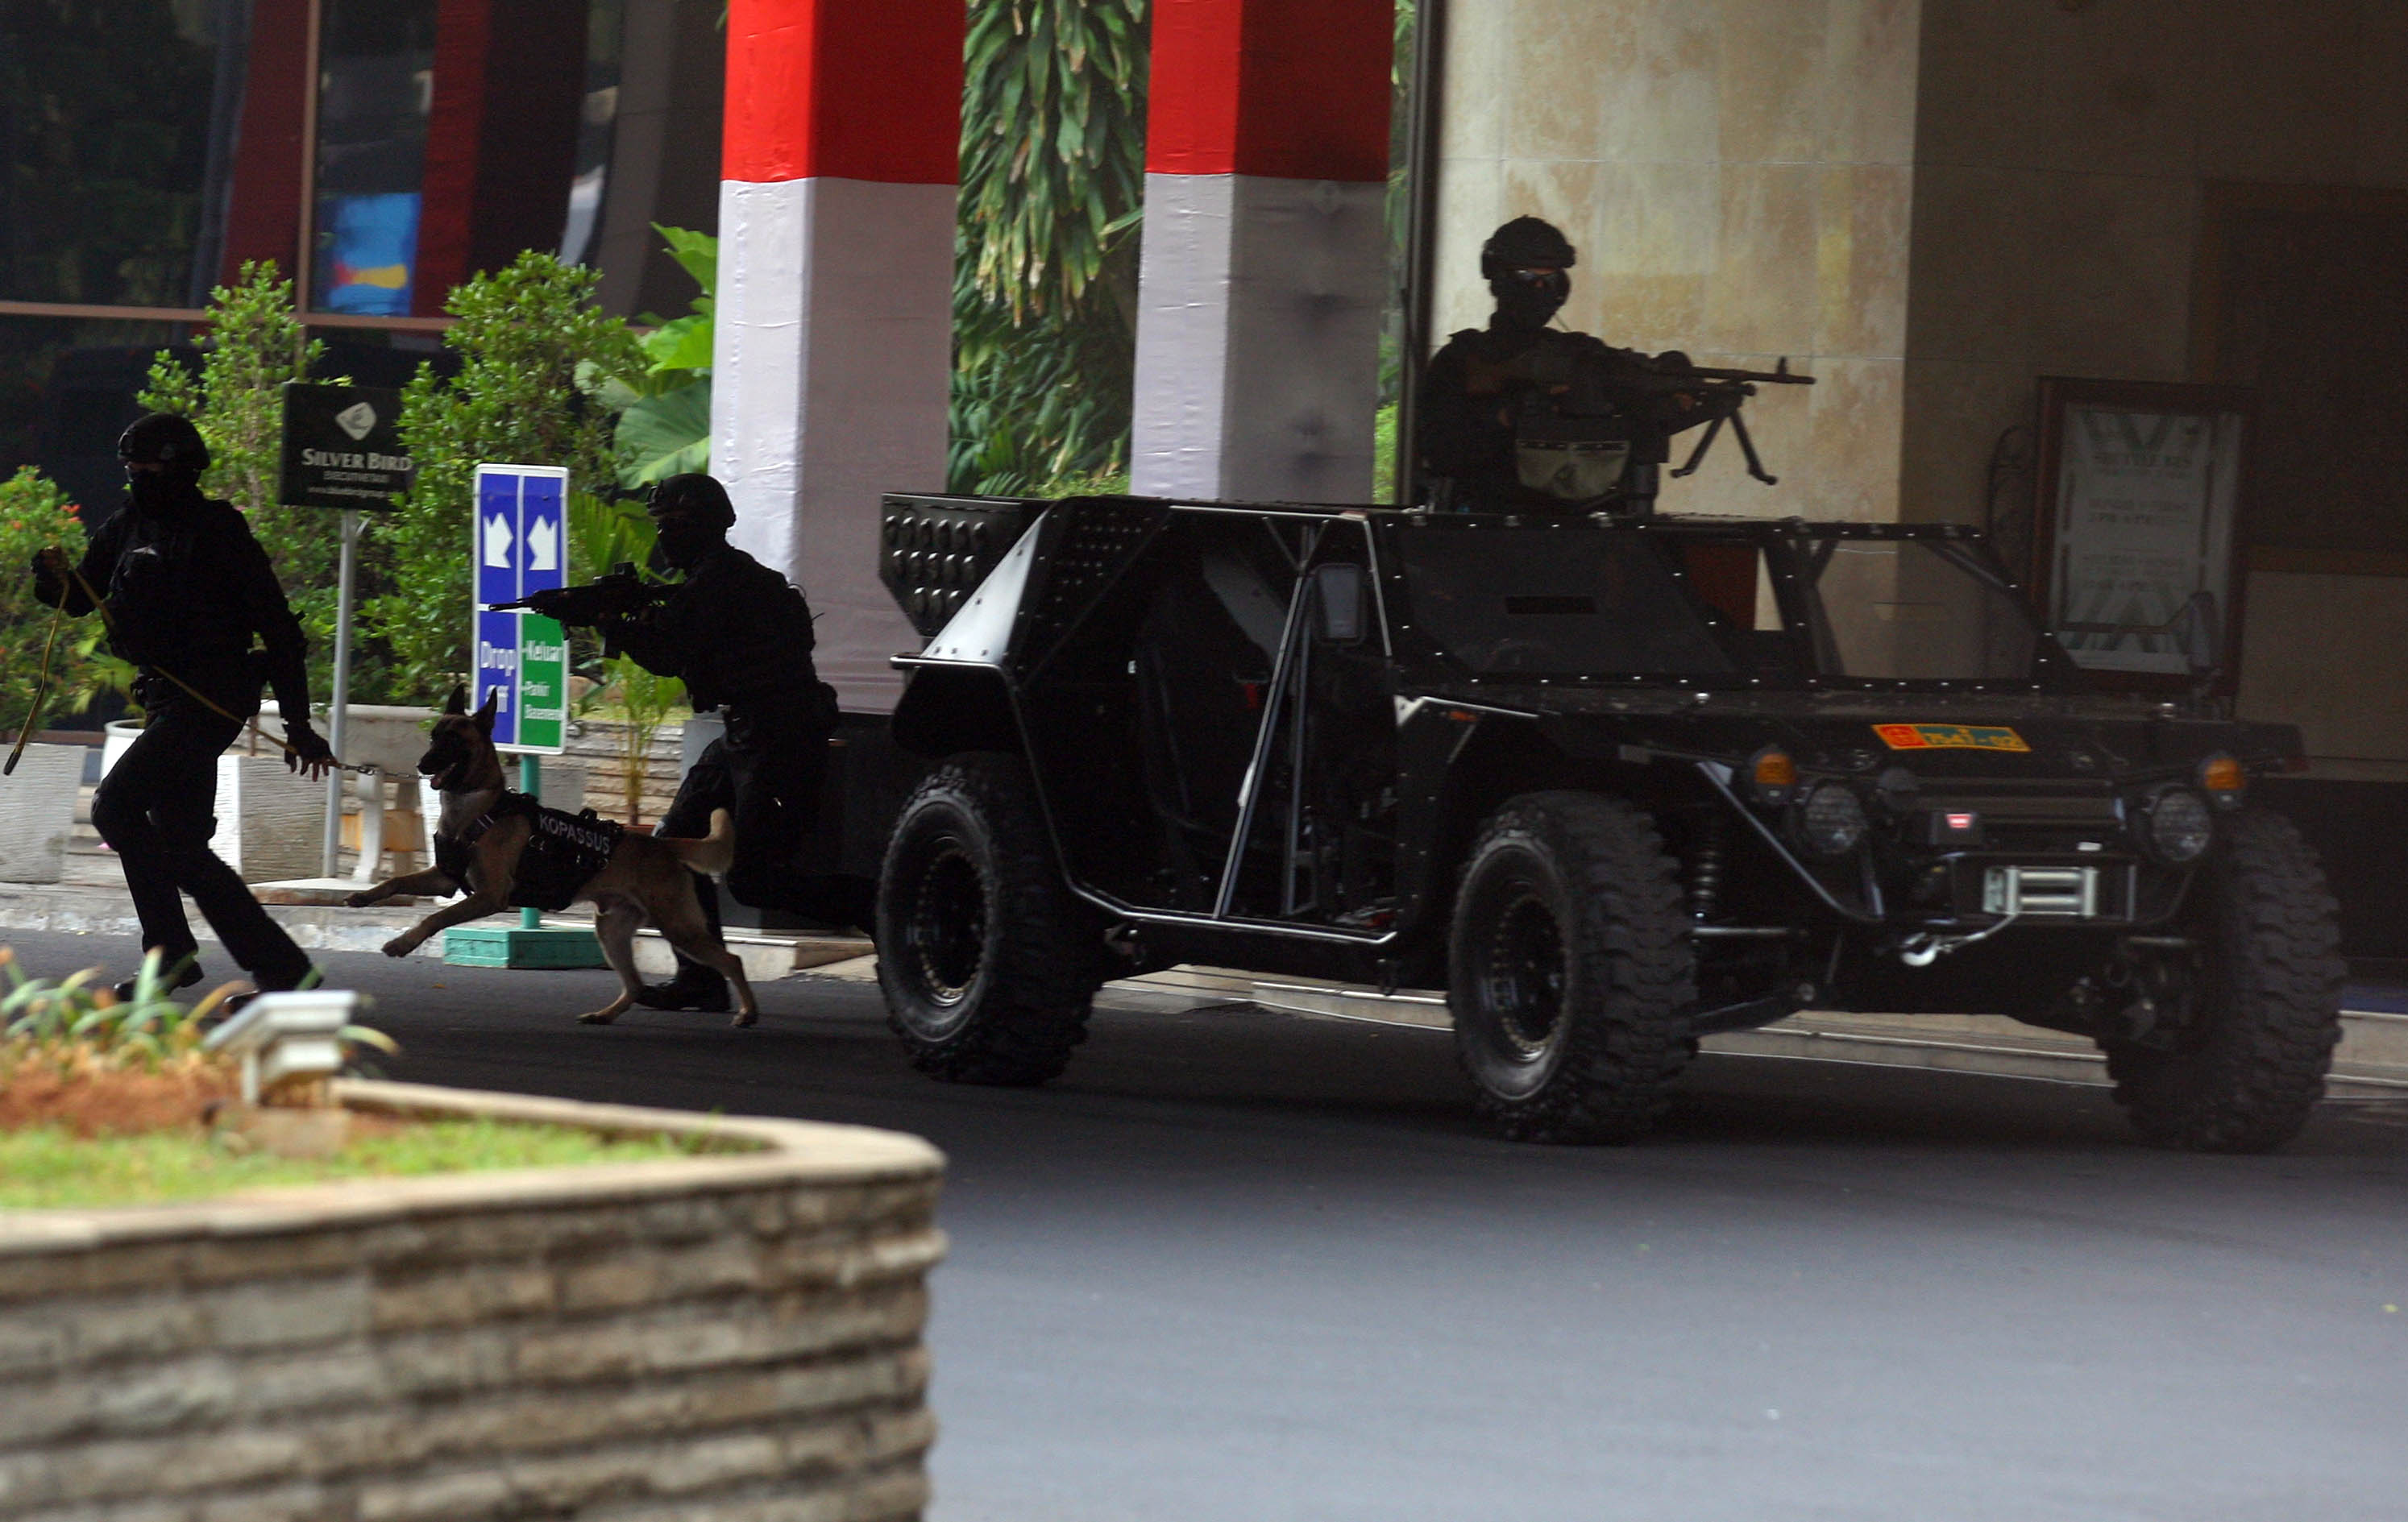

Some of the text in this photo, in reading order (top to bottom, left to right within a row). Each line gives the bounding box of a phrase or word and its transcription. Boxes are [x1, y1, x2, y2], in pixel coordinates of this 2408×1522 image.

[301, 448, 413, 472] SILVER BIRD
[480, 641, 516, 677] Drop
[538, 812, 611, 855] KOPASSUS
